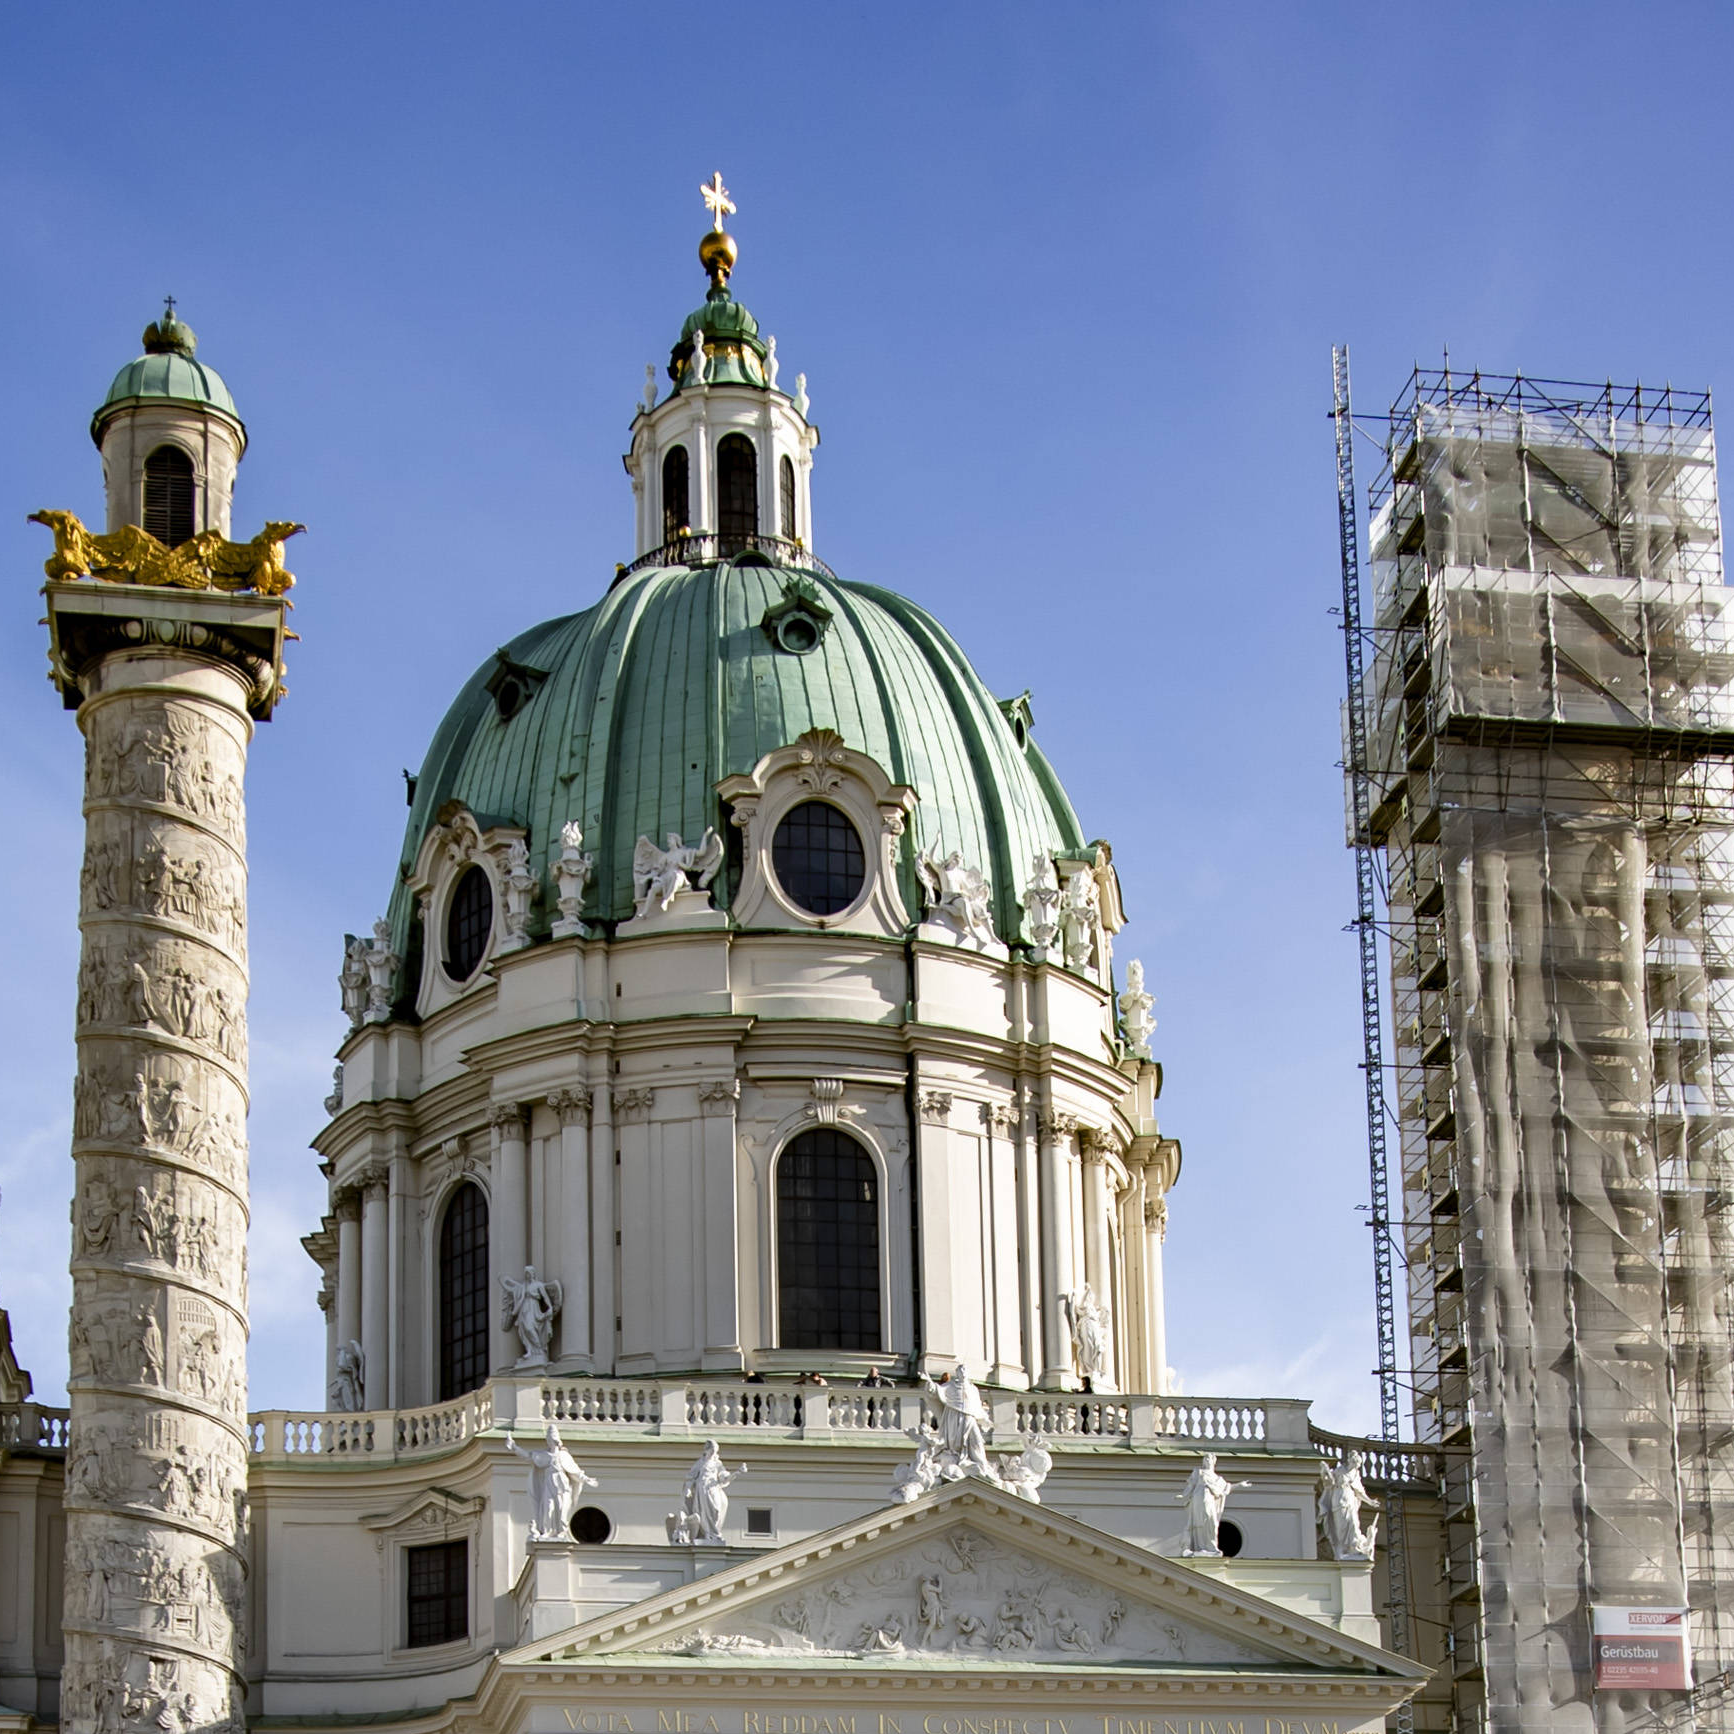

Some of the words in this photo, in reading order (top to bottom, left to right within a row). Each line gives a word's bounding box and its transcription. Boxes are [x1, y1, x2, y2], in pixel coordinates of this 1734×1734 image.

[1629, 1614, 1667, 1625] XERVON
[1600, 1645, 1659, 1658] Gerüstbau
[562, 1708, 634, 1732] VOTA
[658, 1710, 720, 1733] MEA
